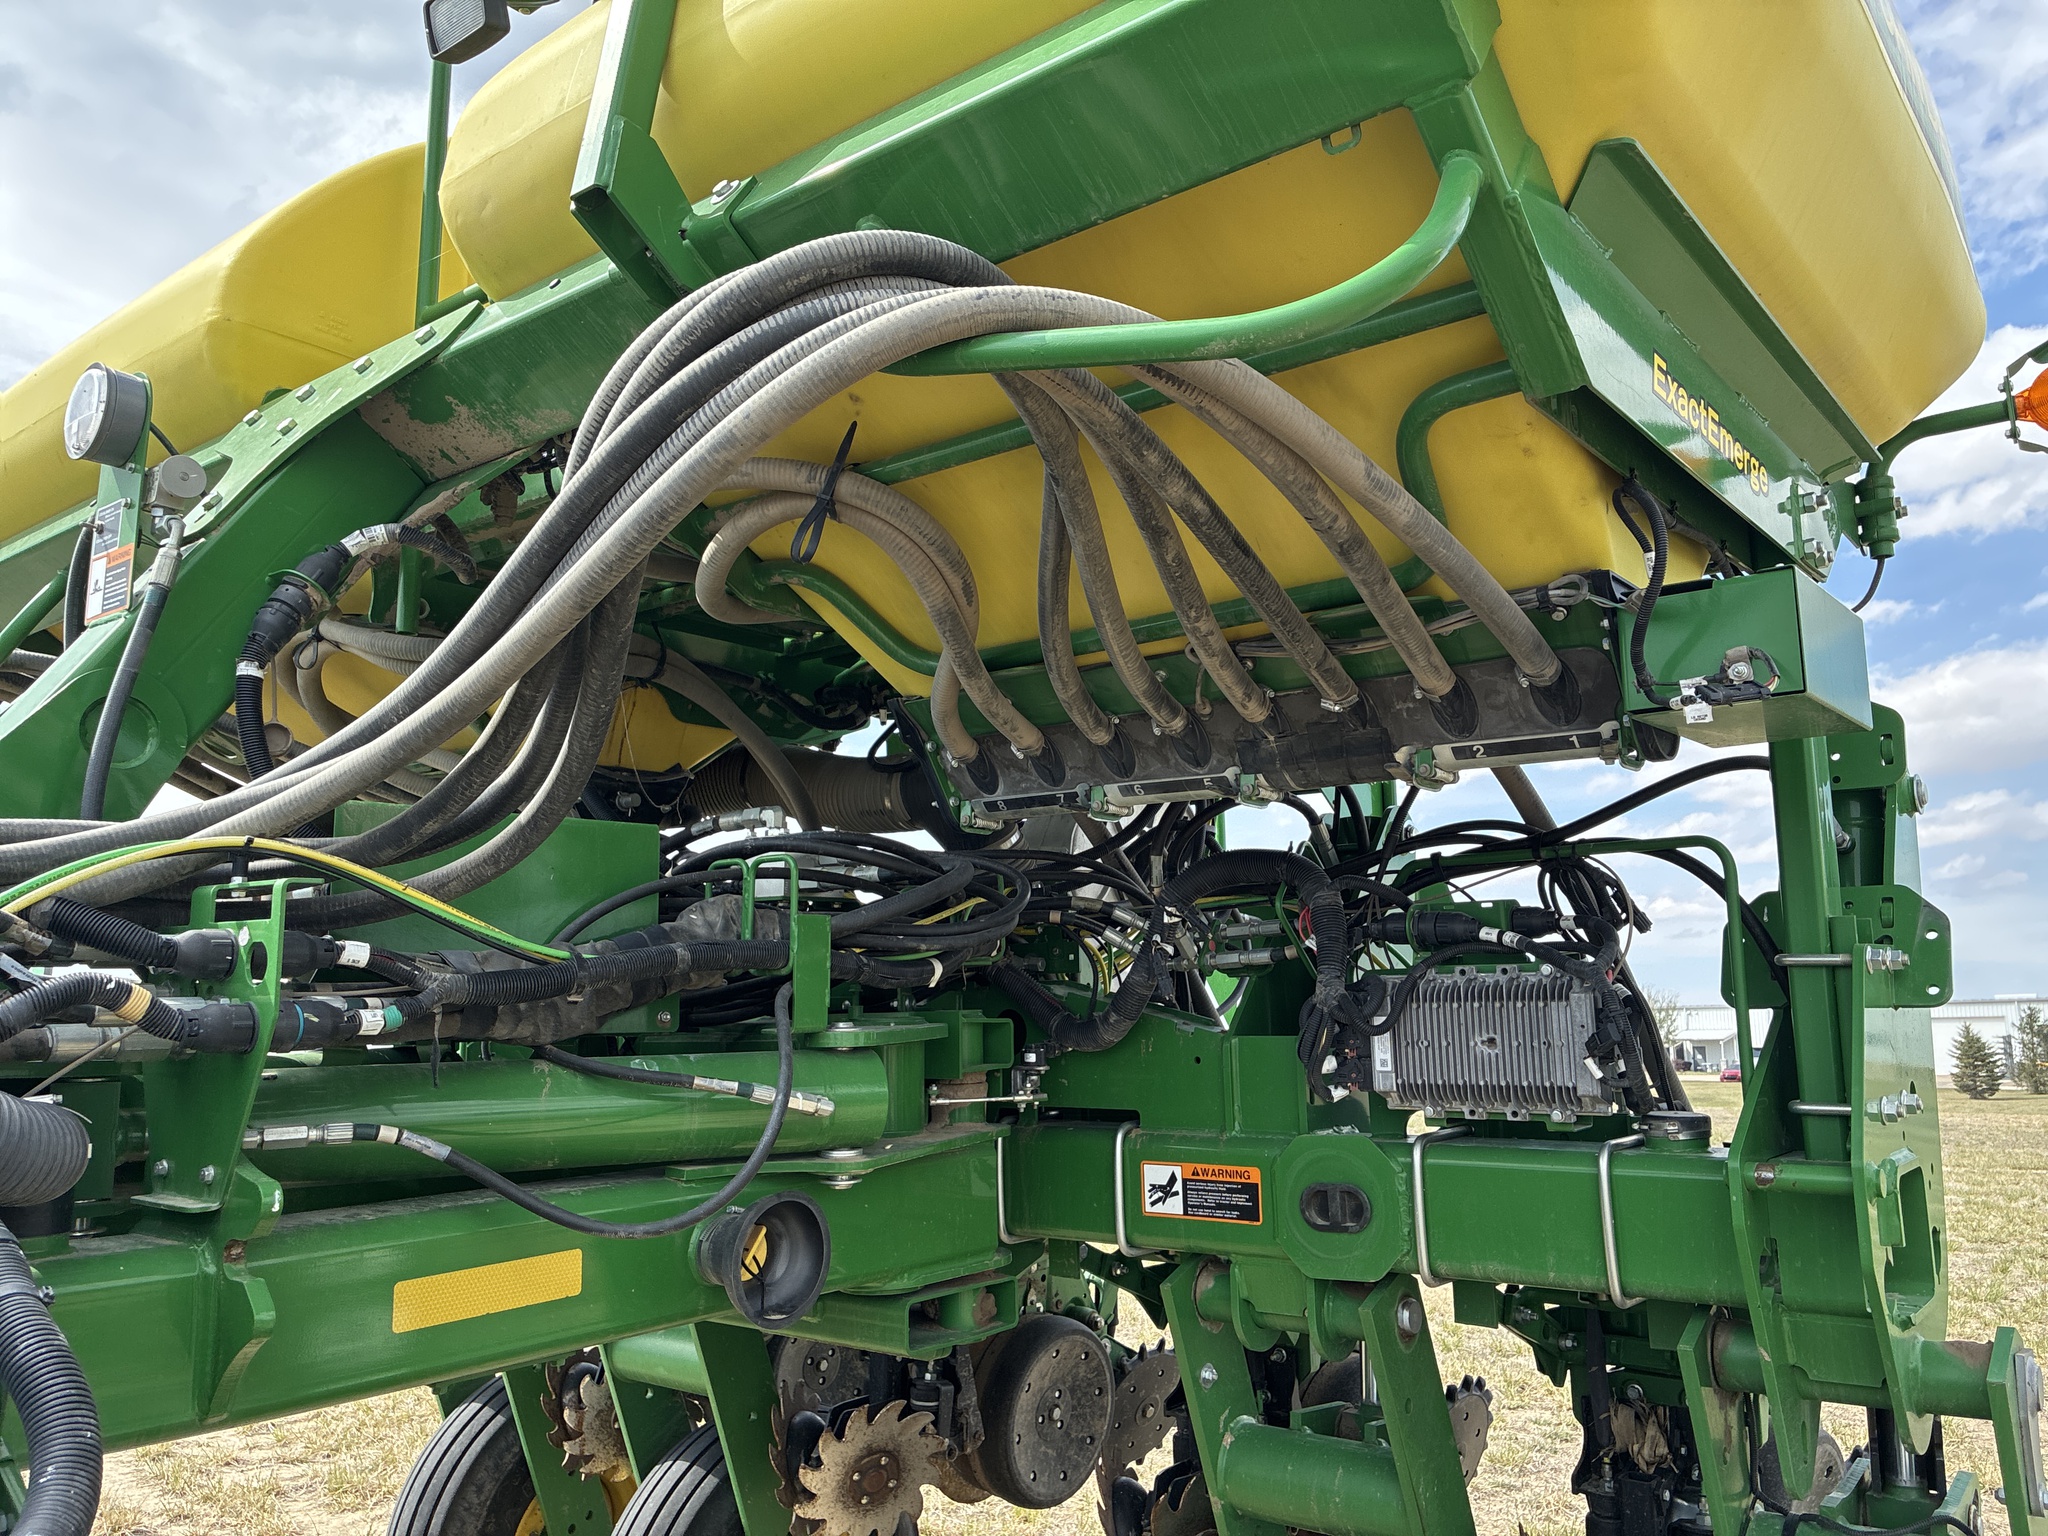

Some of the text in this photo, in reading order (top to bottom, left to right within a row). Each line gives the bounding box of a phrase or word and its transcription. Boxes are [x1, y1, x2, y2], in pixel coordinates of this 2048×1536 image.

[1653, 350, 1768, 495] ExactEmerge
[1473, 735, 1580, 758] 2 1
[1133, 784, 1145, 796] 6
[997, 800, 1008, 811] 8
[1200, 1167, 1251, 1181] WARNING
